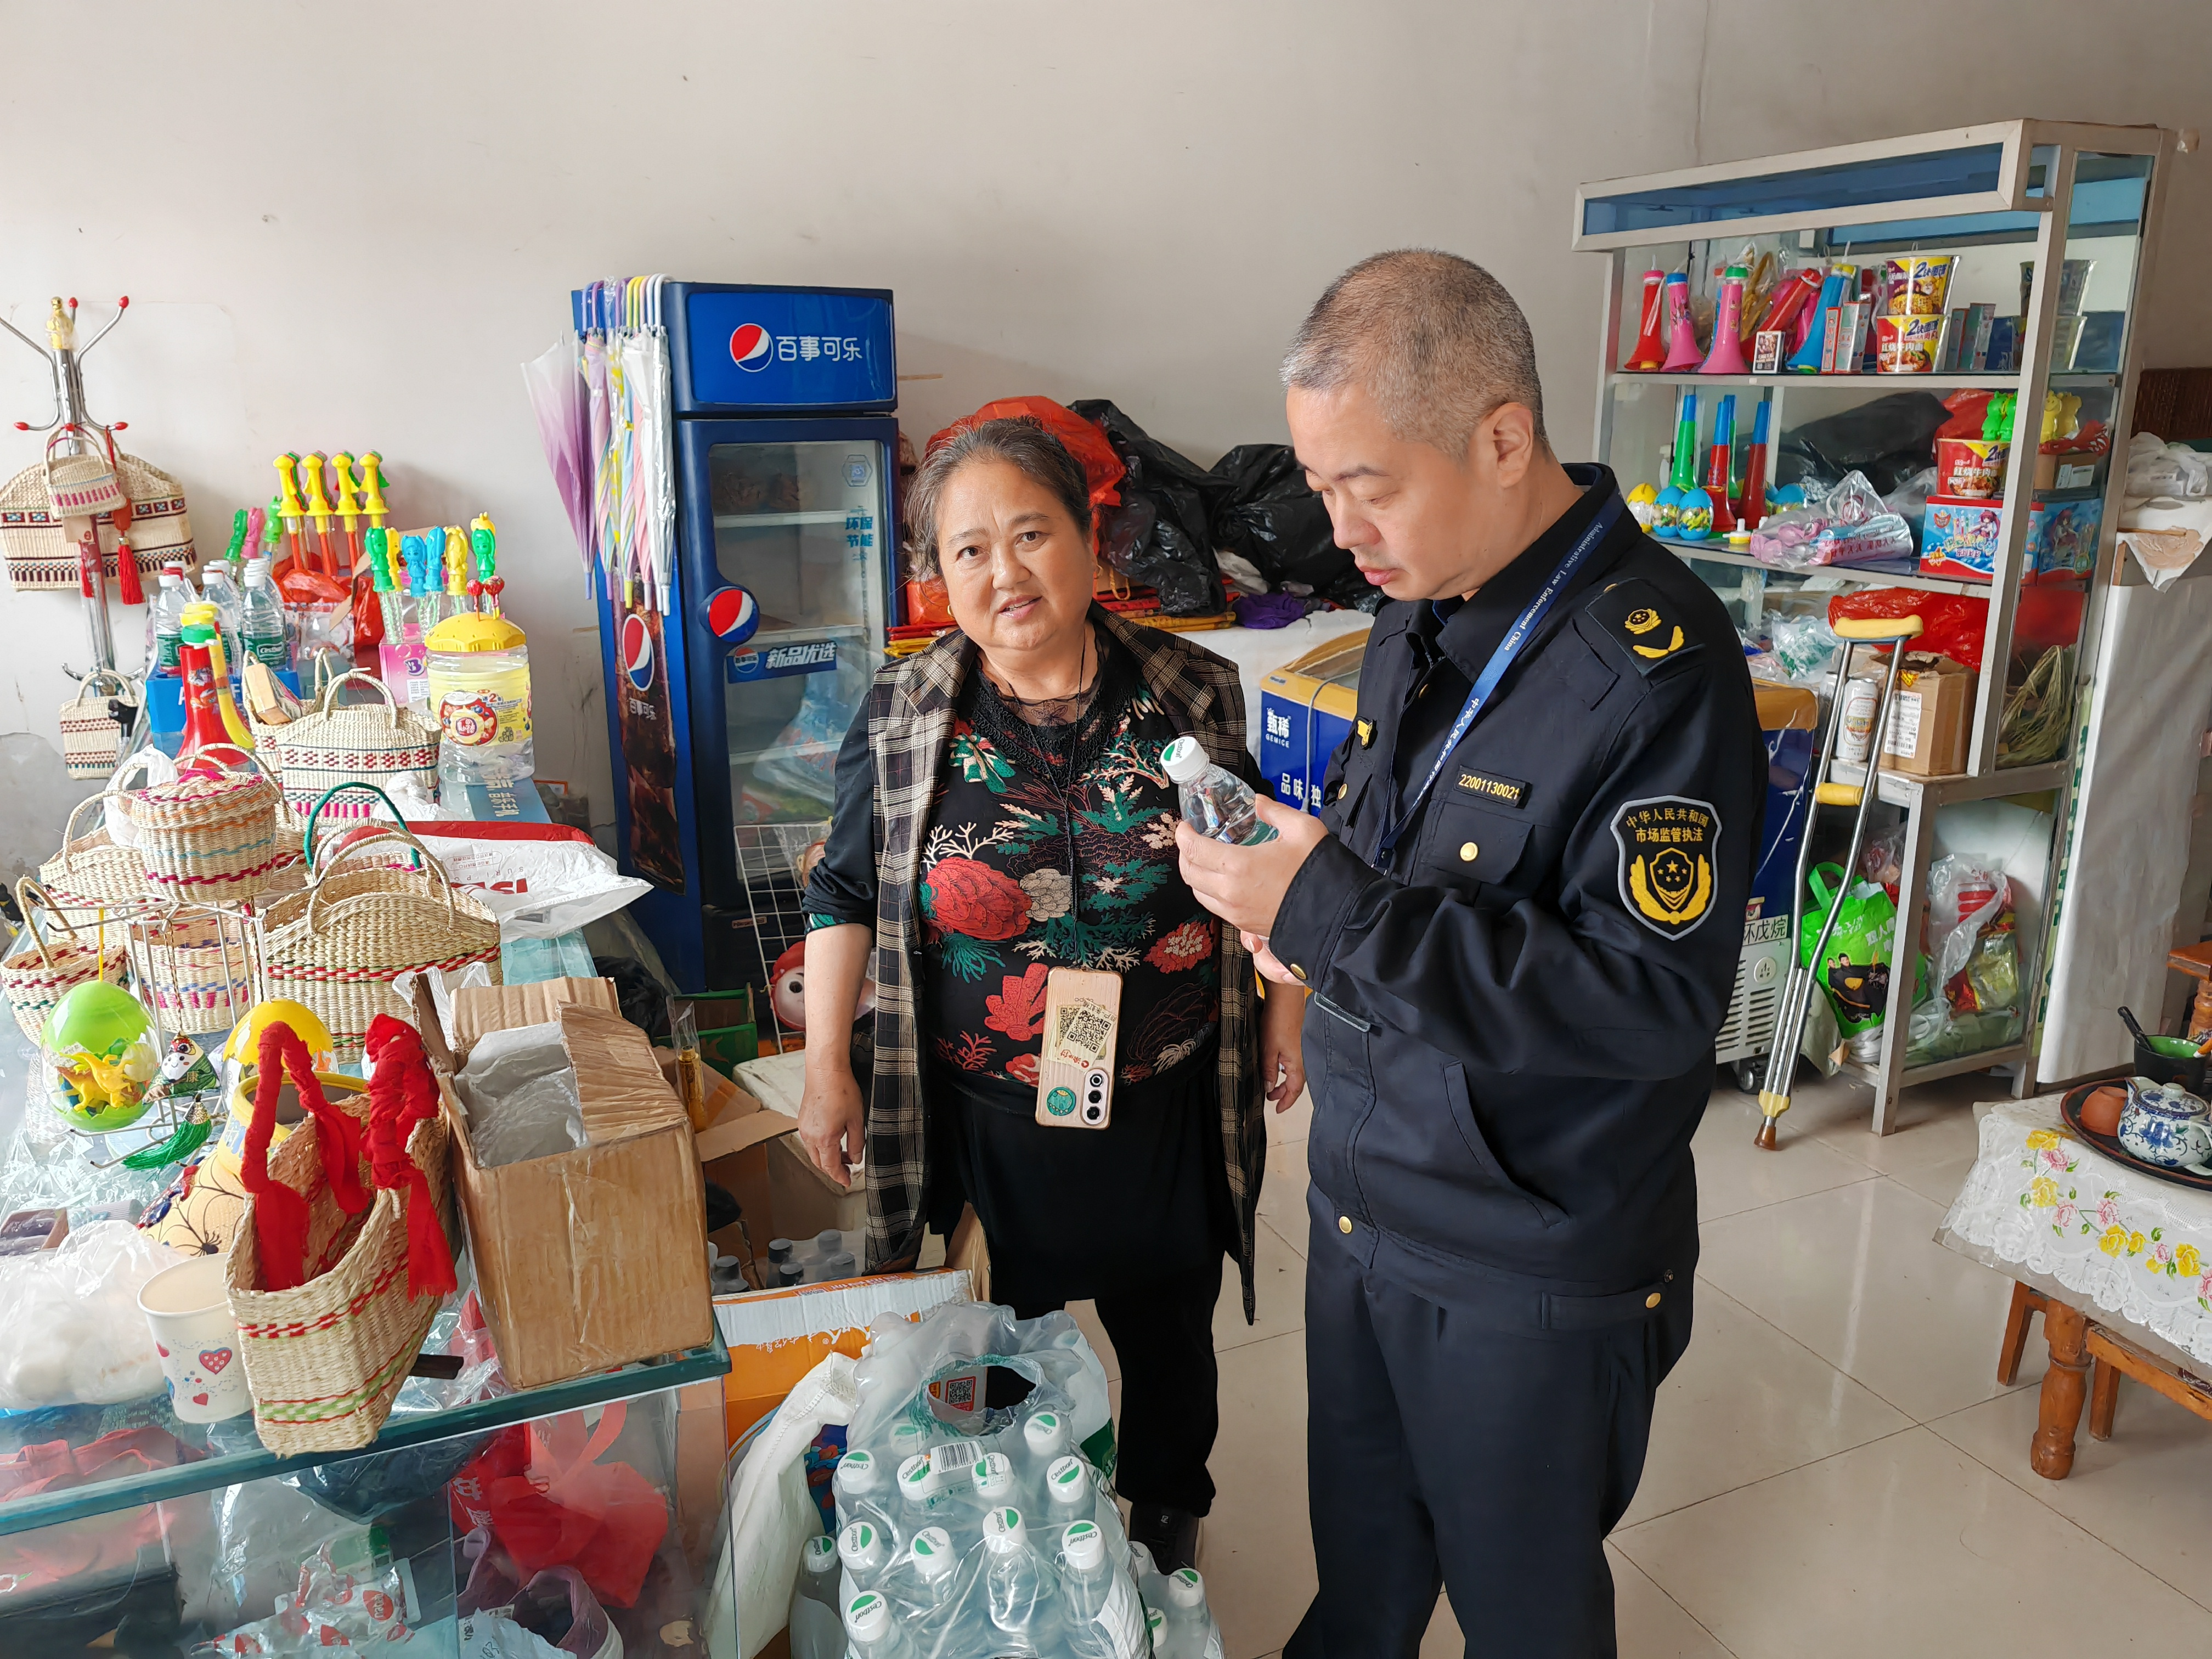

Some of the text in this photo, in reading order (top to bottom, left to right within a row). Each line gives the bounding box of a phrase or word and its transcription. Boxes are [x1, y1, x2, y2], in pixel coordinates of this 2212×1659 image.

[776, 336, 862, 361] 百事可乐
[845, 517, 873, 530] 环保
[847, 534, 873, 547] 节能
[1504, 522, 1603, 651] Administrative Law Enforcement China
[765, 642, 837, 669] 新品优选
[1266, 733, 1290, 748] GEMICE
[1458, 774, 1520, 800] 22001130021
[1626, 808, 1709, 828] 中华人民共和国
[1635, 827, 1703, 843] 市场监管执法
[187, 1070, 200, 1083] 康
